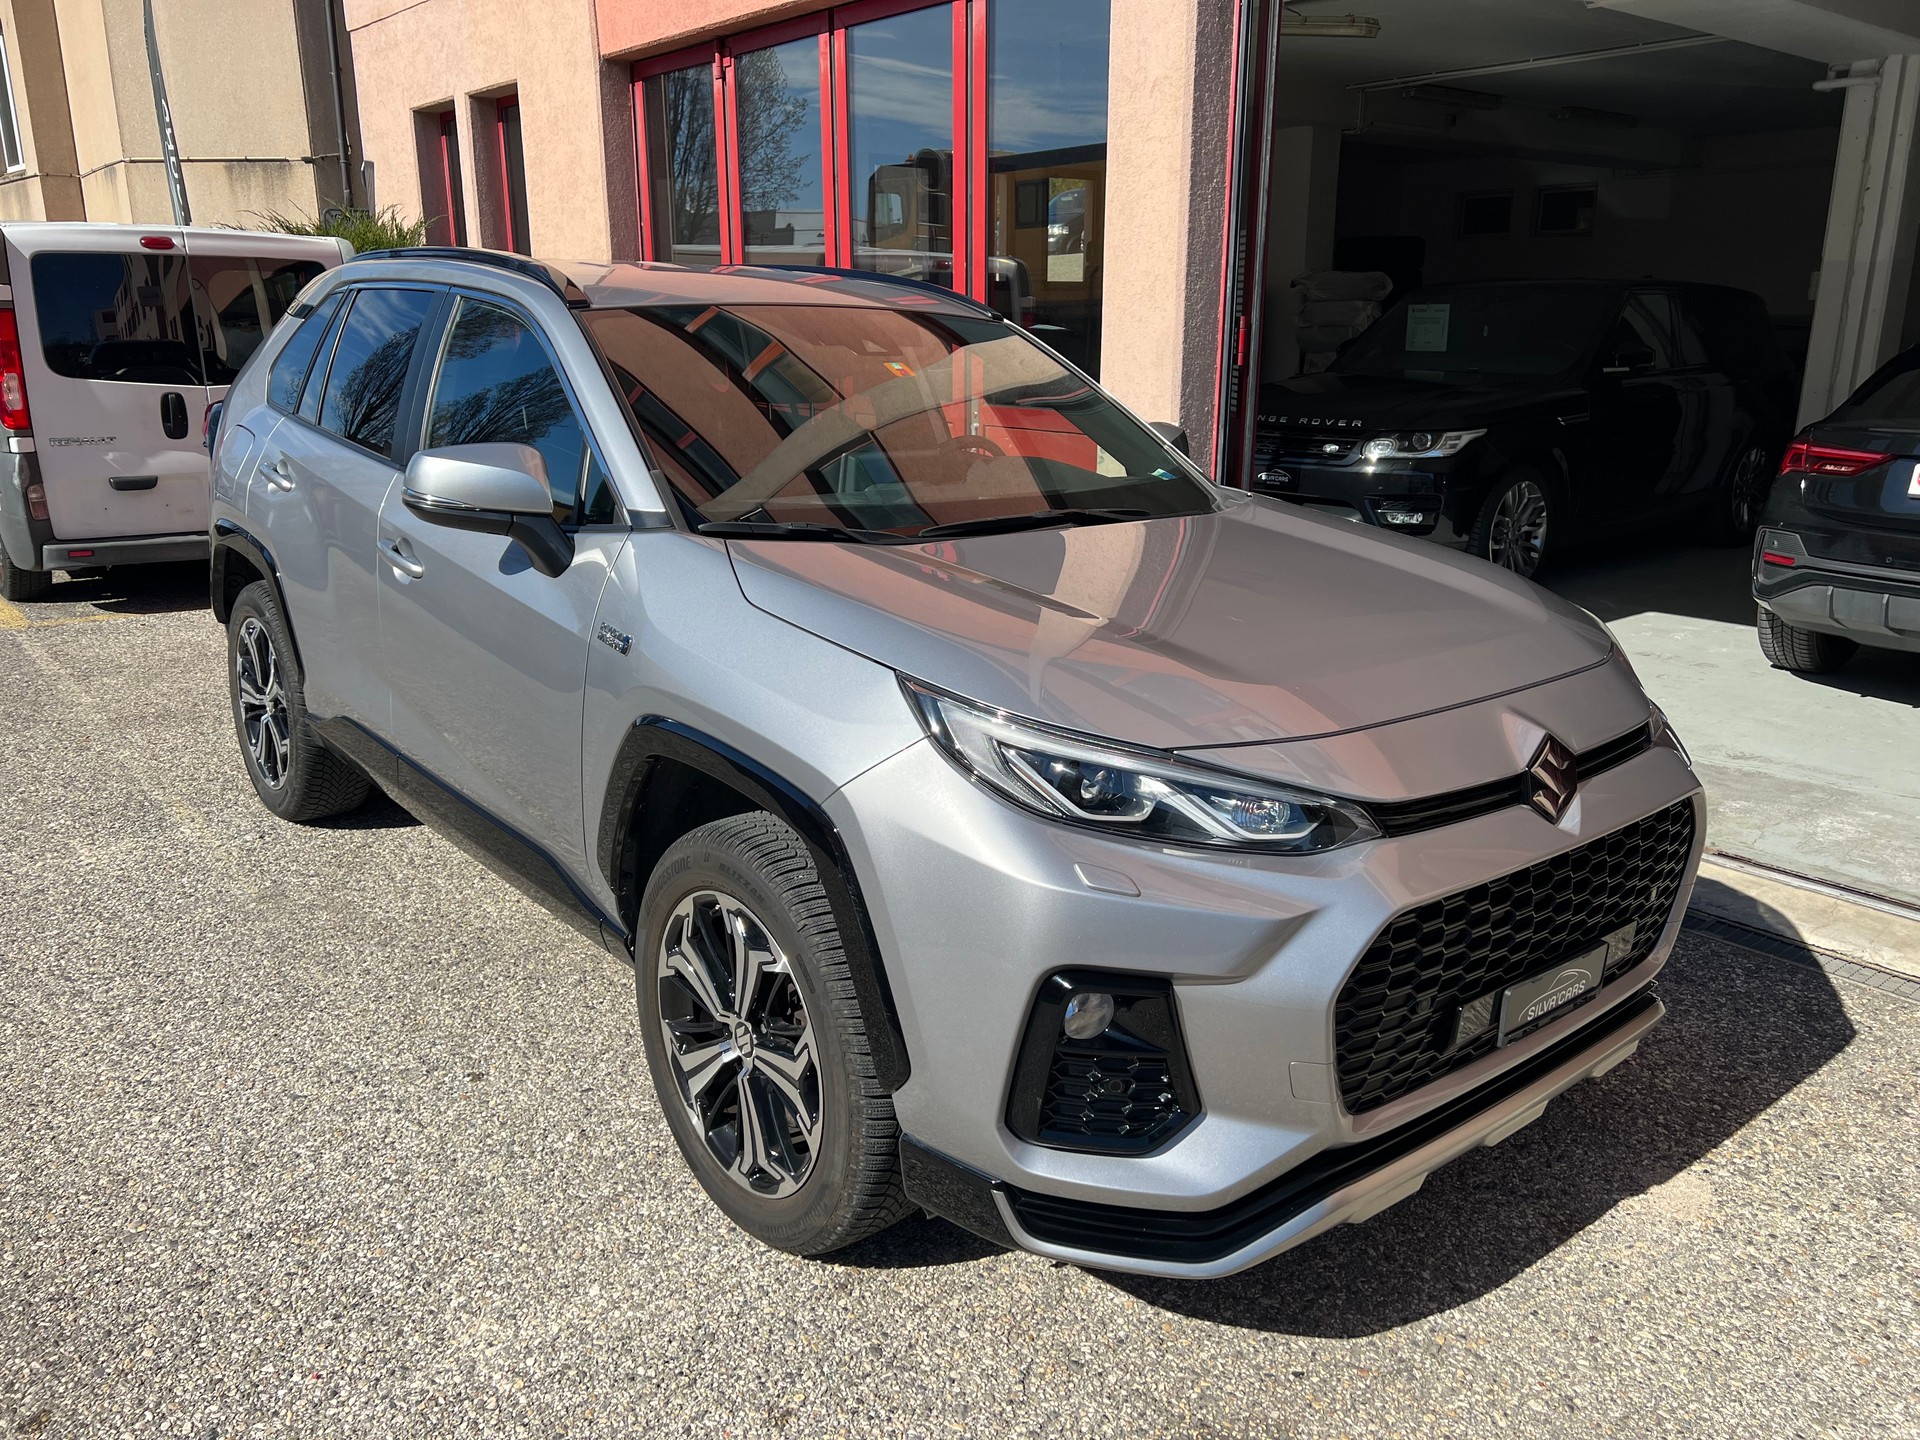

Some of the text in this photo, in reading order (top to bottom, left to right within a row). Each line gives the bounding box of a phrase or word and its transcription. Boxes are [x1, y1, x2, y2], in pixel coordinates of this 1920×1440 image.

[1298, 417, 1363, 427] ROVER
[48, 436, 117, 447] RENAULT
[1527, 979, 1586, 1021] SILVA'CARS
